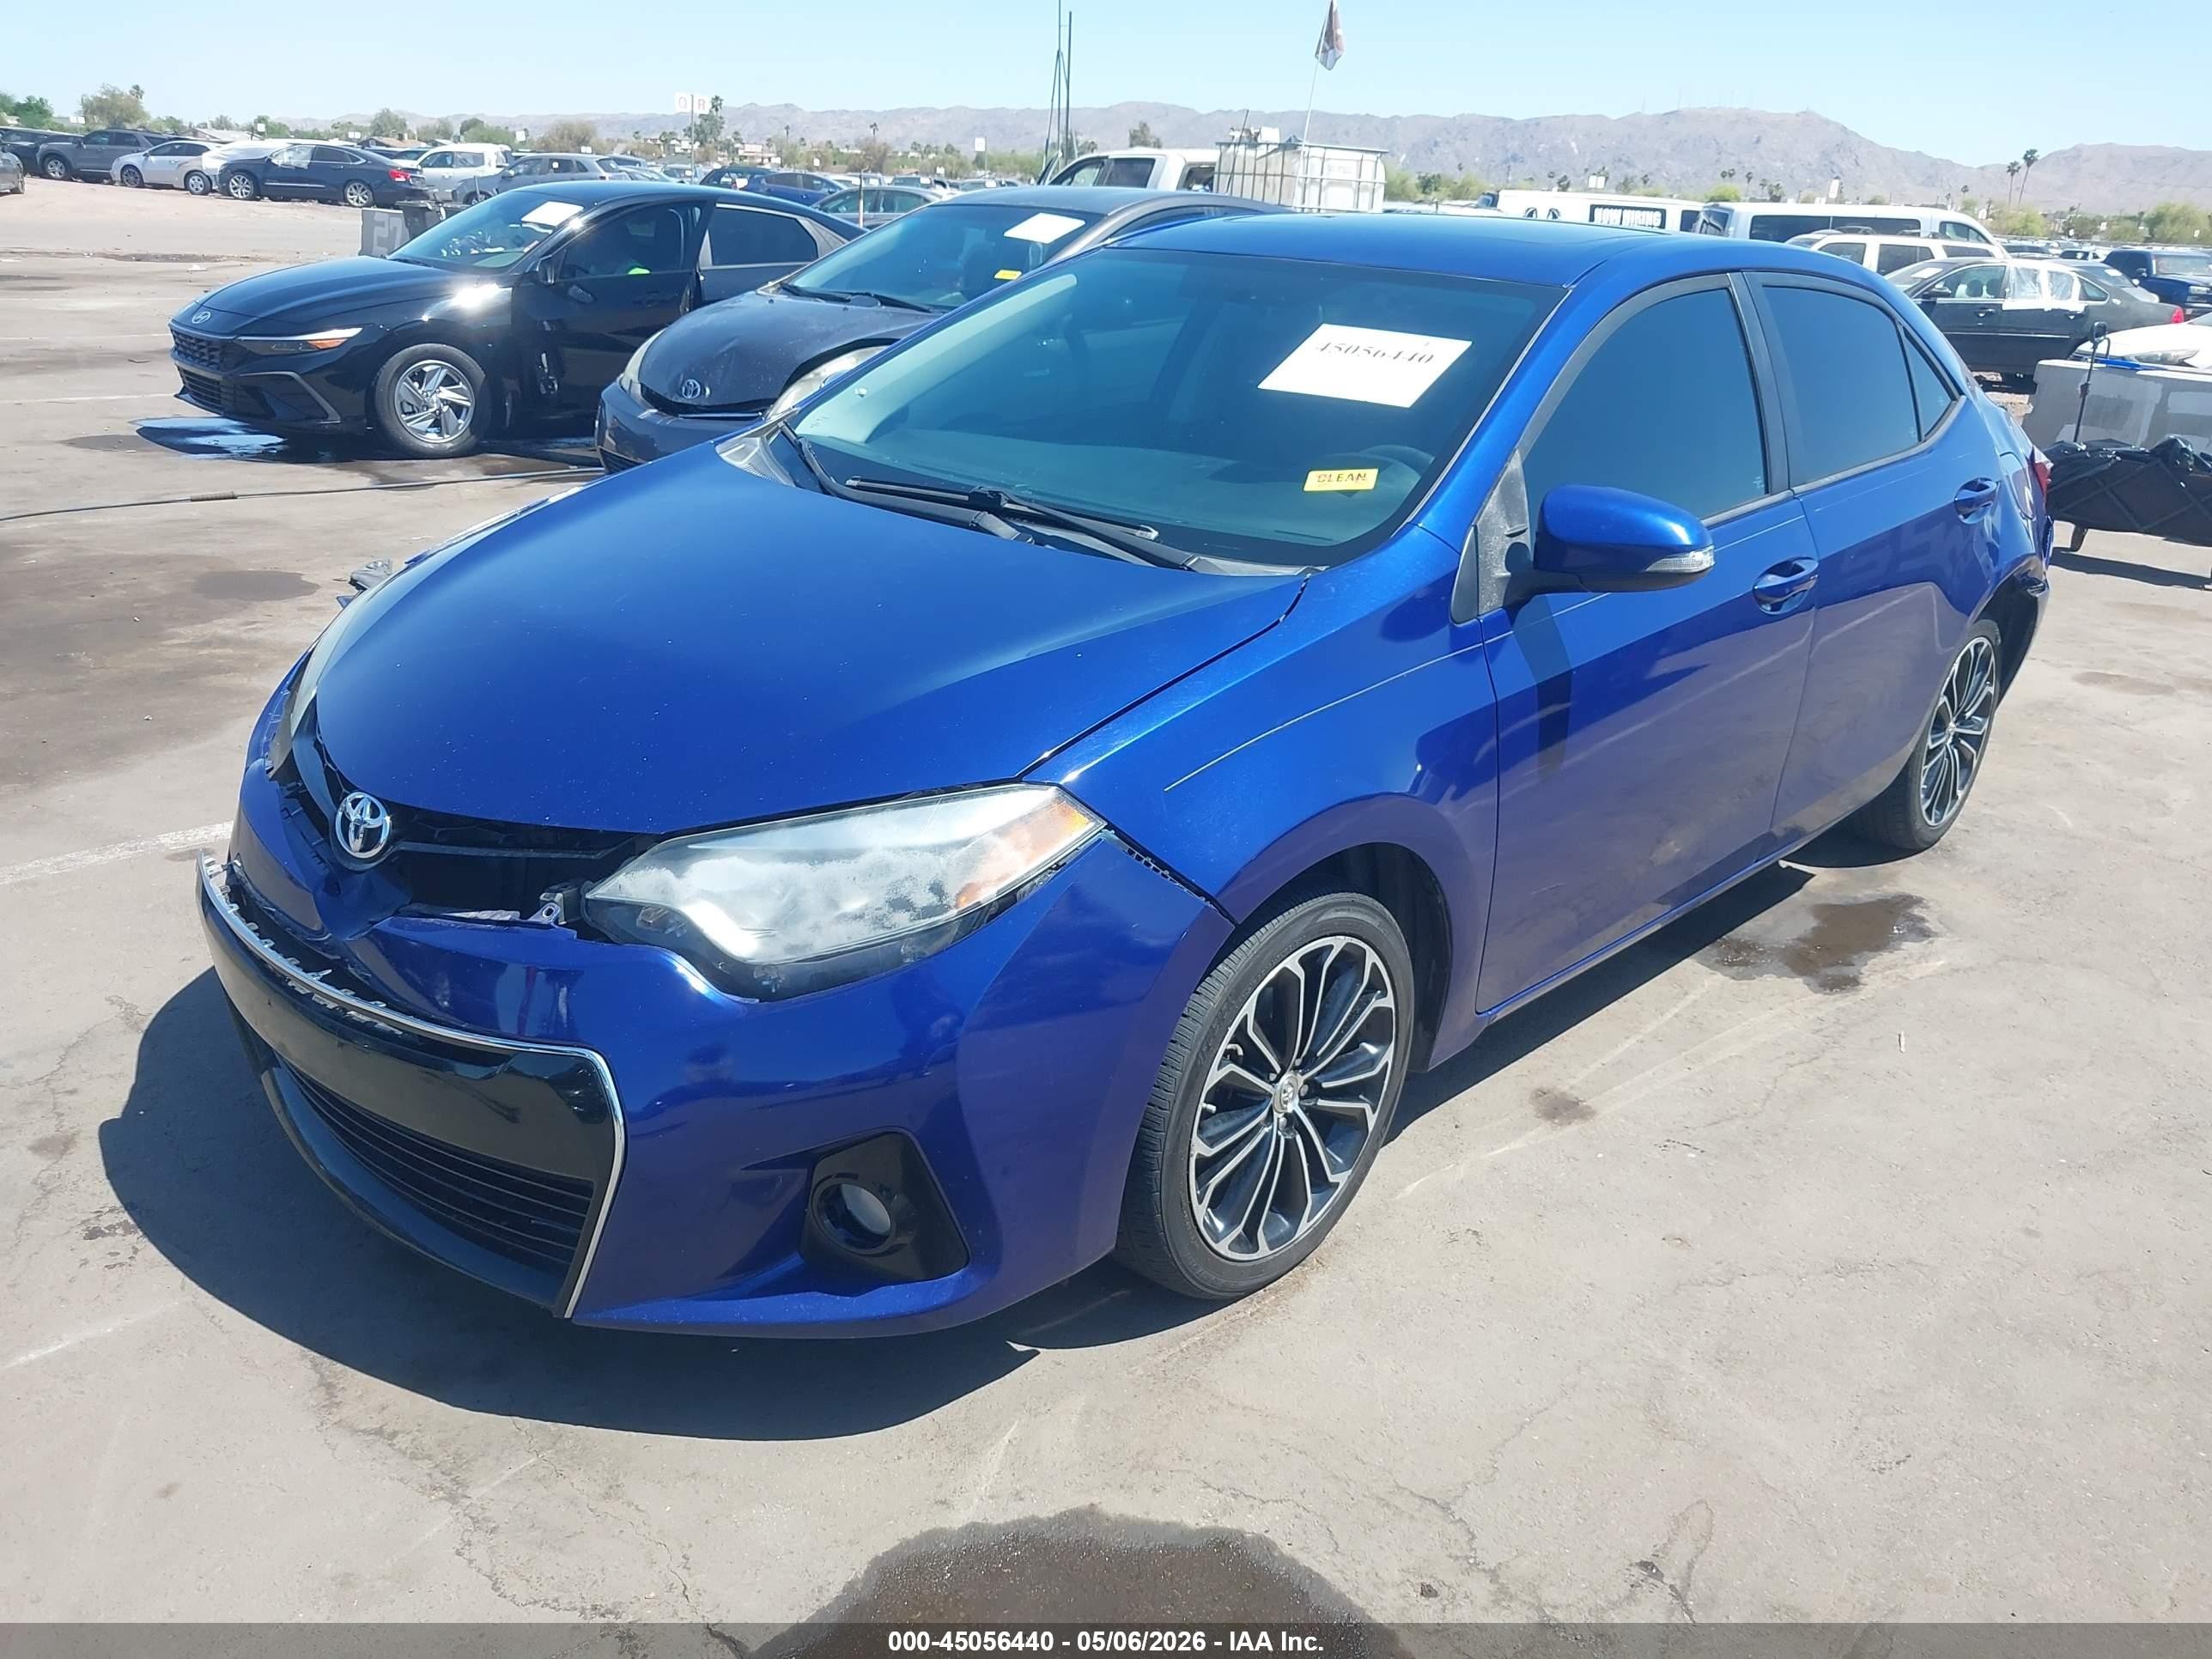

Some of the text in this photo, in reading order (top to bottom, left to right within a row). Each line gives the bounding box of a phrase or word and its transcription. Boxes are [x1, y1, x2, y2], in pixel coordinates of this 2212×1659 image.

[1594, 207, 1662, 227] NOW HIRING
[371, 211, 403, 256] 27
[1316, 472, 1367, 483] CLEAN
